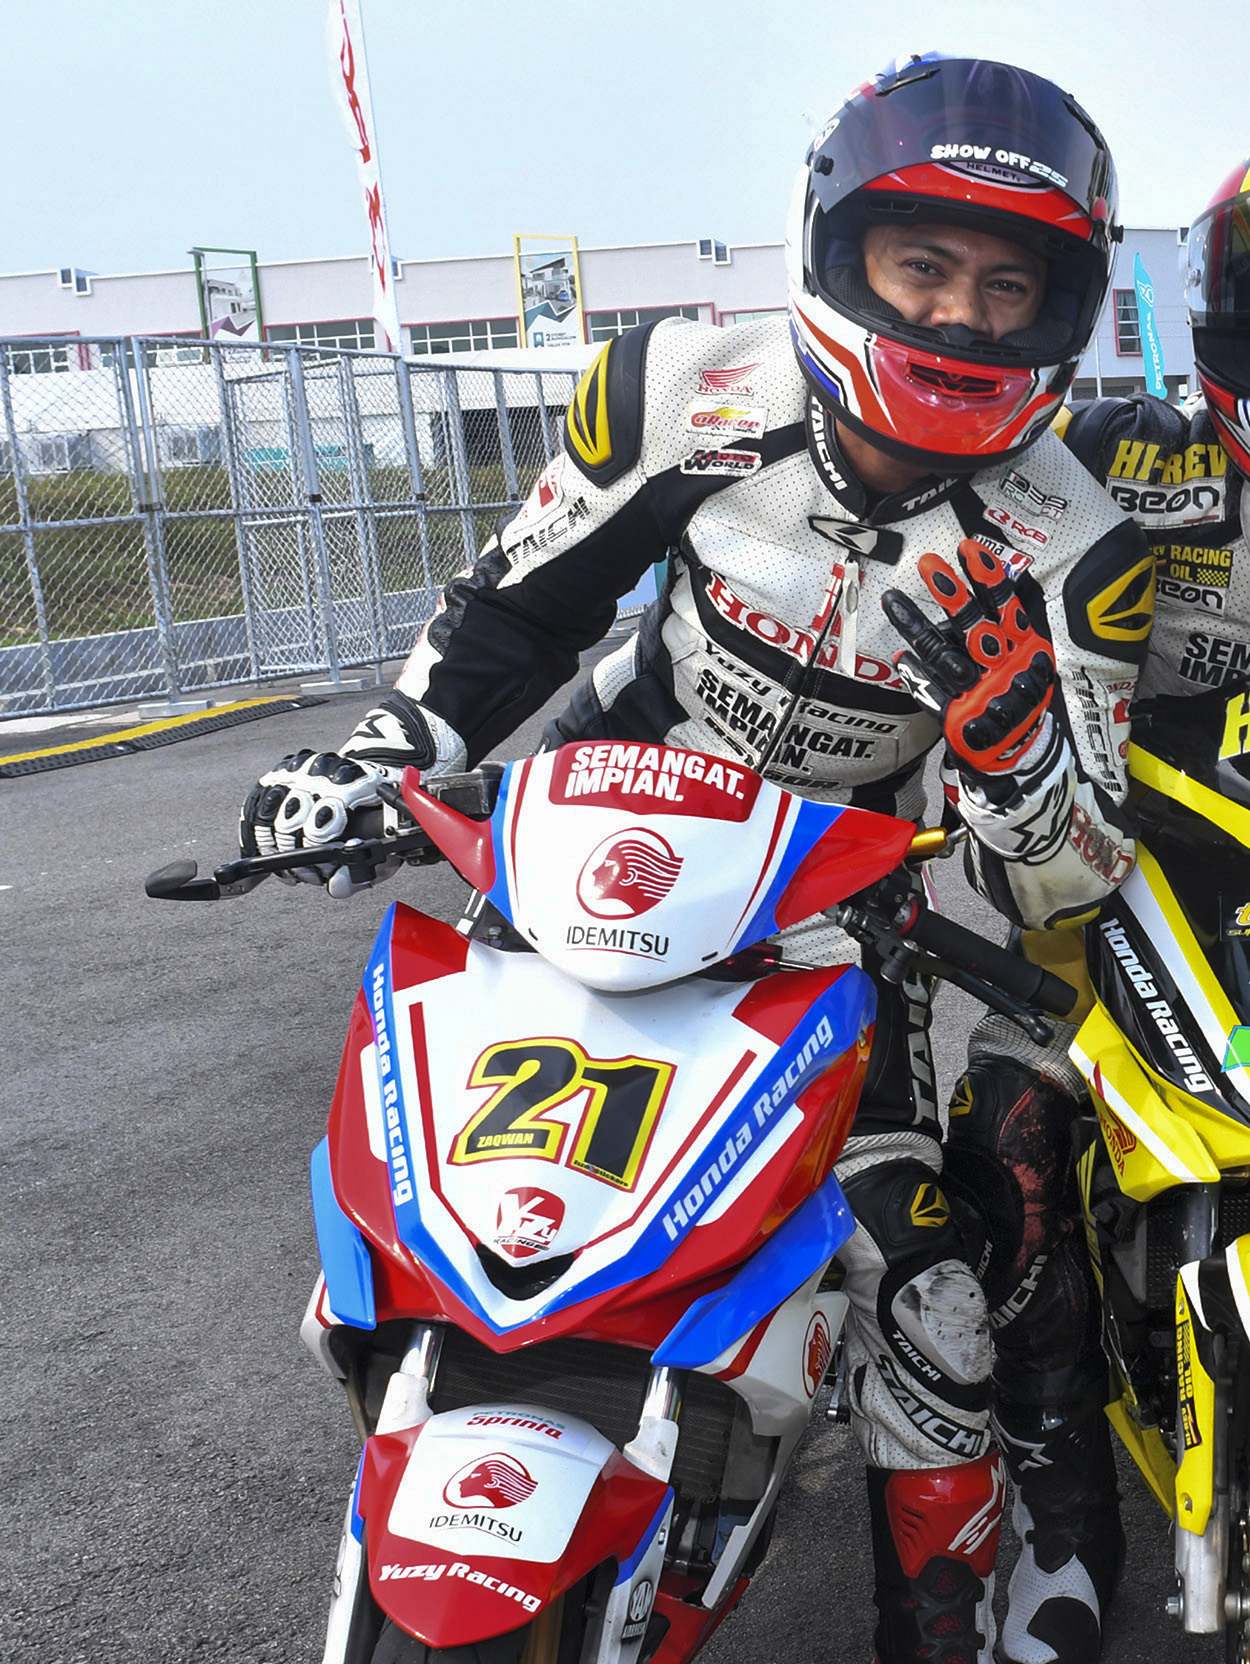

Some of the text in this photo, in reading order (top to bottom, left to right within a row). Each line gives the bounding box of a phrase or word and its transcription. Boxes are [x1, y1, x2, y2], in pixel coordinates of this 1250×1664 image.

[930, 144, 992, 161] SHOW
[995, 149, 1032, 170] OFF
[966, 161, 1020, 182] HELMET
[697, 384, 752, 394] HONDA
[684, 459, 755, 471] WORLD
[690, 449, 757, 463] MOTO
[1109, 439, 1228, 485] HI-REV
[506, 496, 591, 566] TAICHI
[1169, 562, 1194, 582] OIL
[1170, 544, 1231, 567] RACING
[705, 572, 906, 688] HOND
[564, 768, 684, 803] IMPIAN.
[571, 744, 744, 800] SEMANGAT.
[566, 924, 670, 956] IDEMITSU
[1100, 918, 1216, 1095] Honda Racing
[372, 964, 414, 1207] Honda Racing
[446, 1036, 678, 1193] 21
[663, 1014, 834, 1242] Honda Racing
[476, 1132, 535, 1149] ZAQWAN
[891, 1329, 943, 1382] TAICHI
[1176, 1325, 1187, 1402] RACING
[1184, 1363, 1193, 1399] OIL
[466, 1415, 563, 1440] Sprinta
[428, 1512, 523, 1544] IDEMITSU
[379, 1561, 543, 1614] Yuzy Racing
